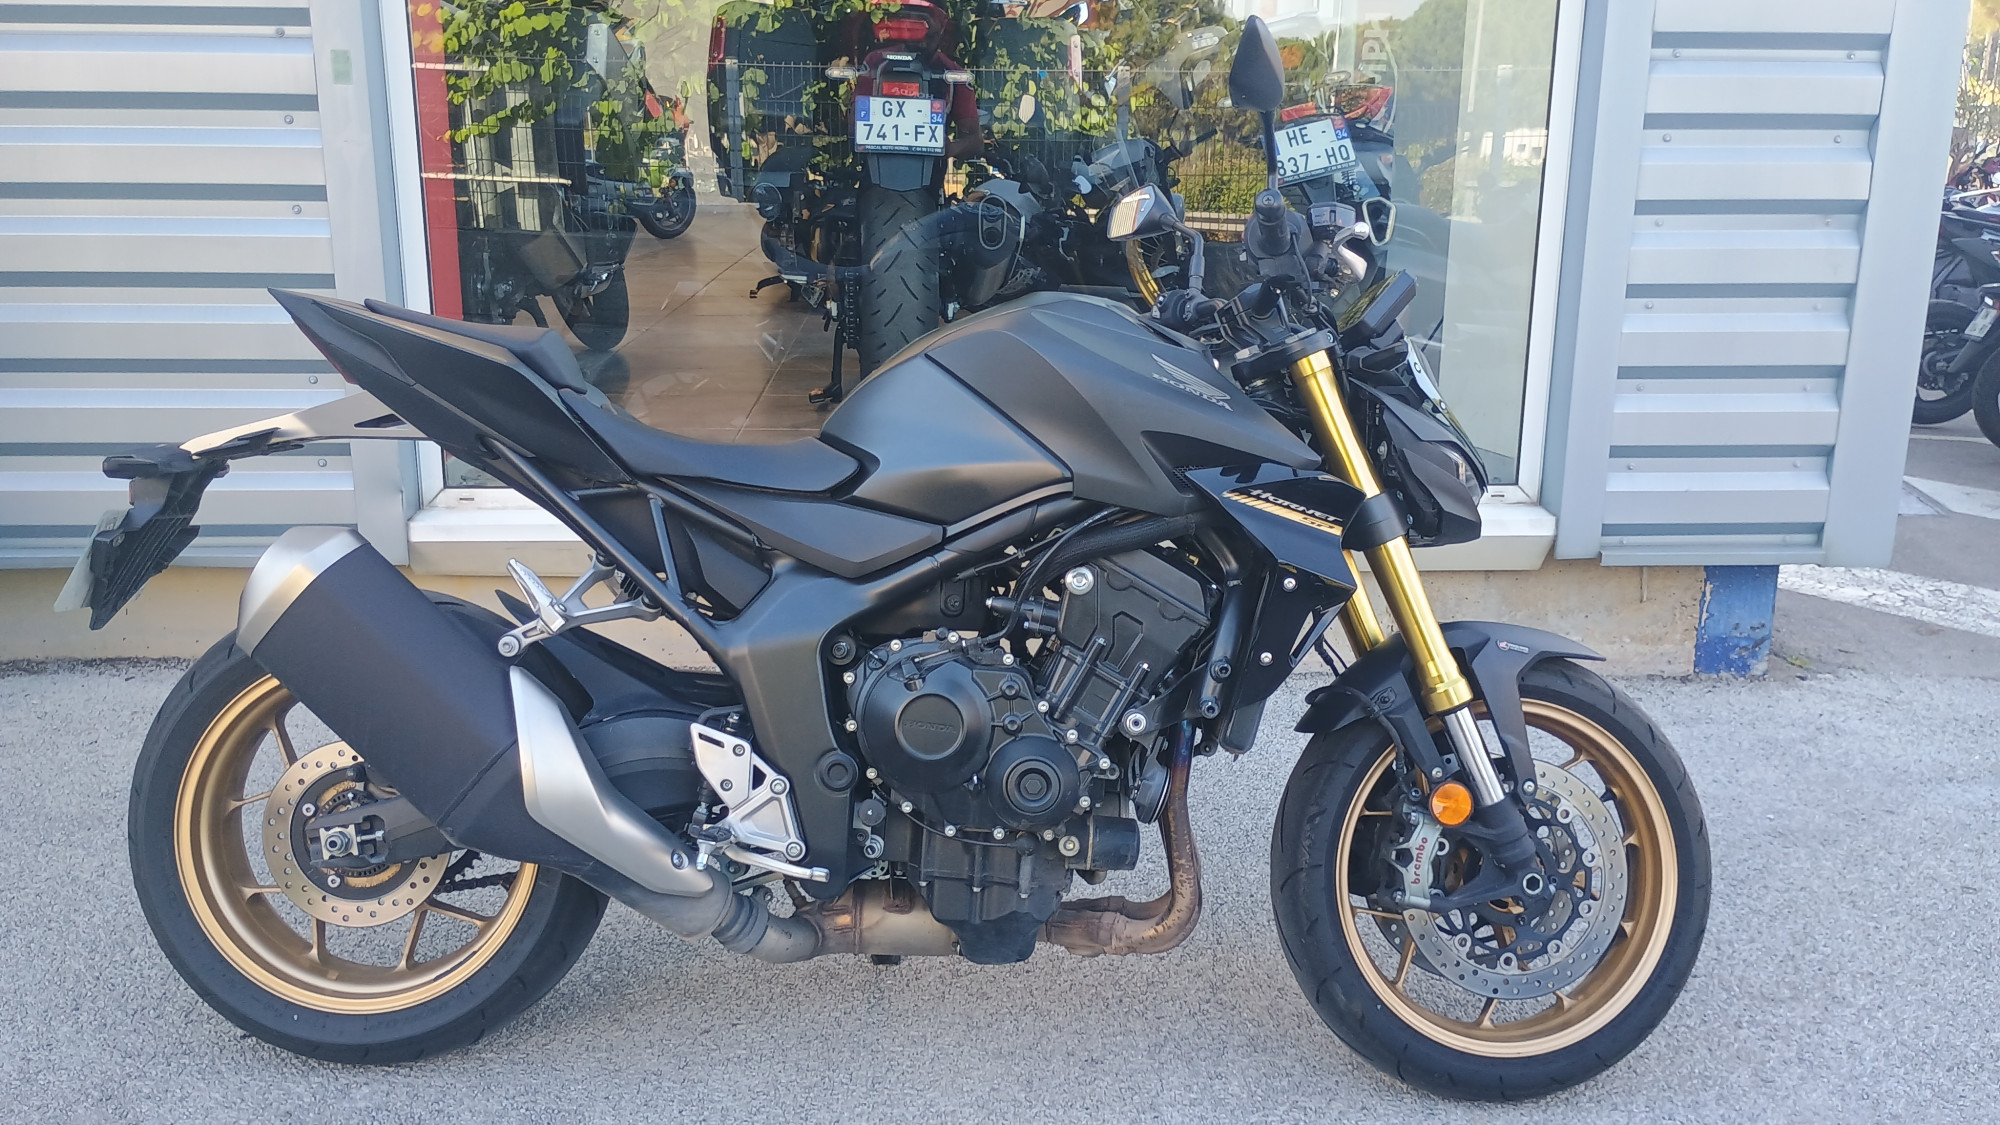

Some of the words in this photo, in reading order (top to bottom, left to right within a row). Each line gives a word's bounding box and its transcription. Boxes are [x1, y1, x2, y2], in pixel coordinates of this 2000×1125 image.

[882, 101, 906, 118] GX
[931, 114, 943, 123] 34
[863, 123, 939, 143] 741-FX
[1286, 126, 1312, 148] HE
[1335, 129, 1348, 139] 34
[1152, 372, 1234, 412] HONDA
[903, 720, 957, 734] HONDA
[1411, 837, 1428, 885] brembo
